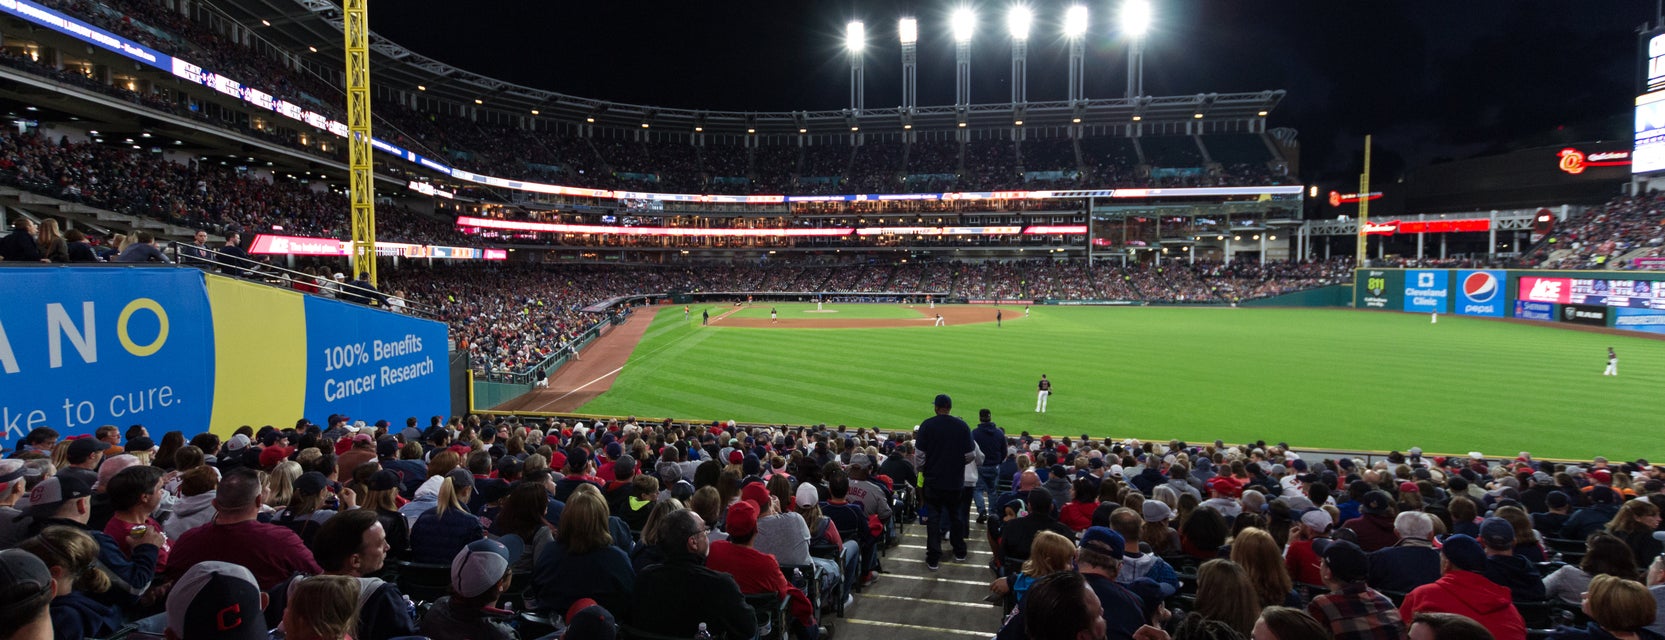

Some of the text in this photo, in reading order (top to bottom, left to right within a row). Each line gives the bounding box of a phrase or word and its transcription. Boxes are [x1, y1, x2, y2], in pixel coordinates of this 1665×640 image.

[289, 242, 302, 251] The
[1367, 277, 1384, 290] 811
[1529, 278, 1562, 297] ACE
[1405, 288, 1447, 297] Cleveland
[1412, 297, 1437, 306] Clinic
[1465, 304, 1494, 313] pepsi
[324, 334, 422, 372] 100% Benefits
[324, 355, 433, 402] Cancer Research
[63, 398, 95, 428] to
[110, 385, 182, 418] cure.
[848, 486, 867, 499] UBER
[217, 603, 242, 631] C
